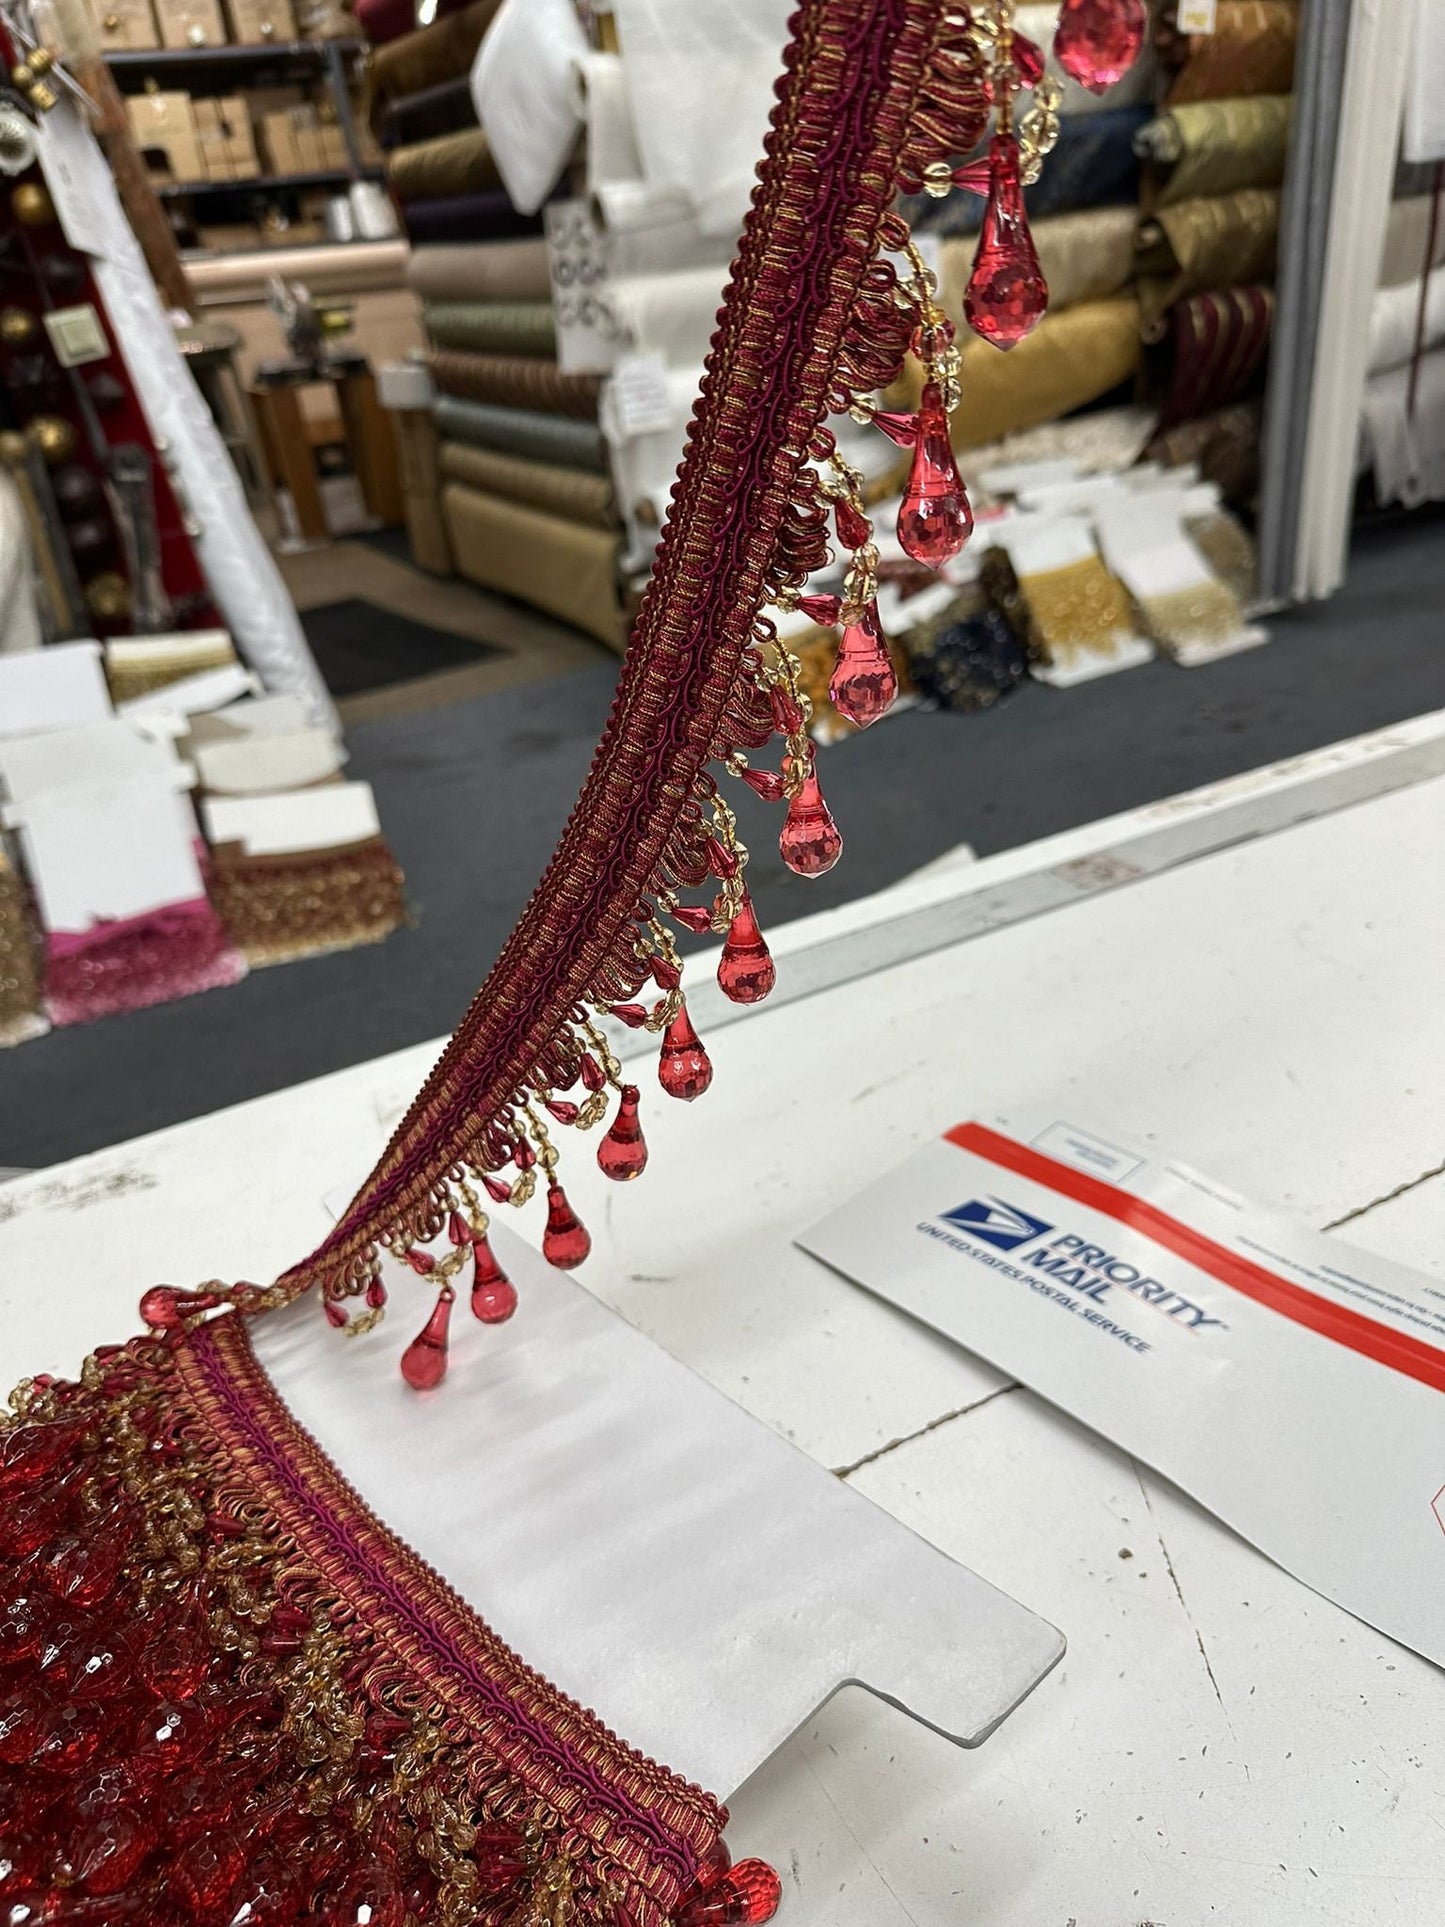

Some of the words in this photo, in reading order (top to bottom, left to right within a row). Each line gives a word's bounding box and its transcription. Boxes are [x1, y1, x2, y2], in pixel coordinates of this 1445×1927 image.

[916, 1220, 973, 1251] UNITED
[972, 1248, 1024, 1279] STATES
[1019, 1275, 1082, 1312] POSTAL
[1077, 1307, 1152, 1354] SERVICE
[1020, 1247, 1112, 1304] MAIL
[1048, 1233, 1222, 1328] PRIORITY
